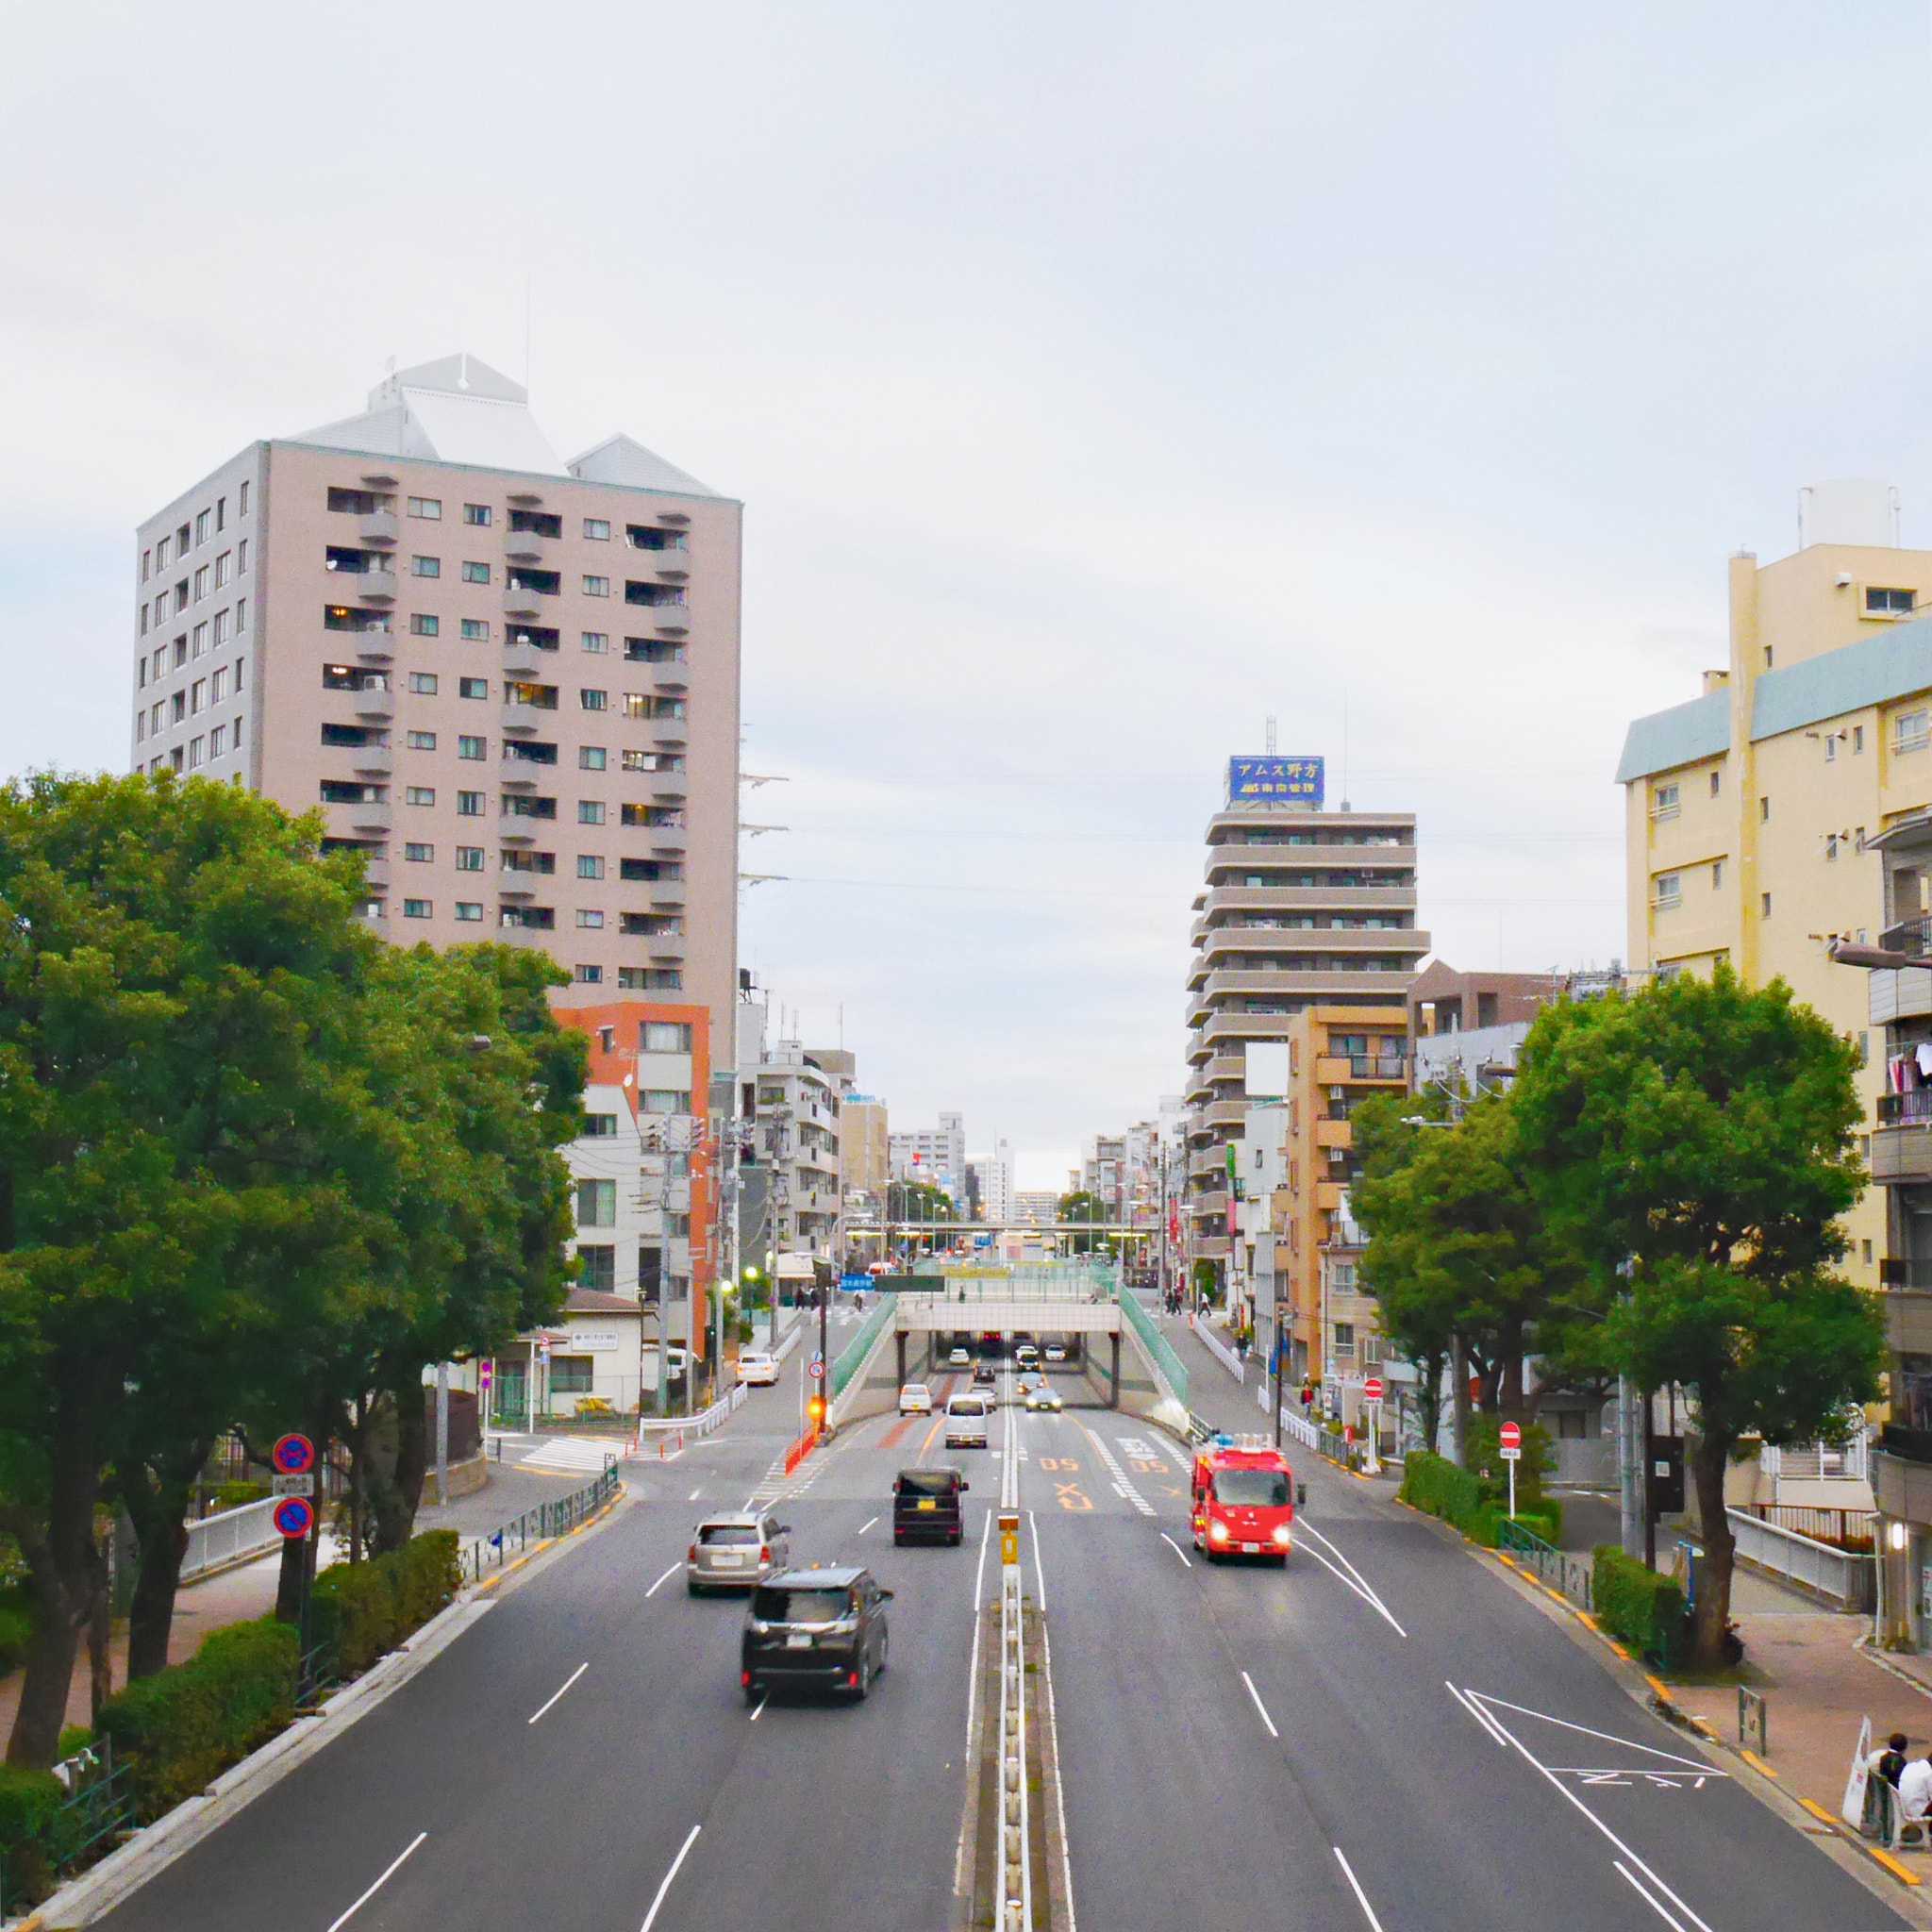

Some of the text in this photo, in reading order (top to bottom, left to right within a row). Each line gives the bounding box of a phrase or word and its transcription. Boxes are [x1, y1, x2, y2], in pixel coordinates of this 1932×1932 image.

[1240, 764, 1318, 778] アムス野方
[1040, 1457, 1079, 1472] 50
